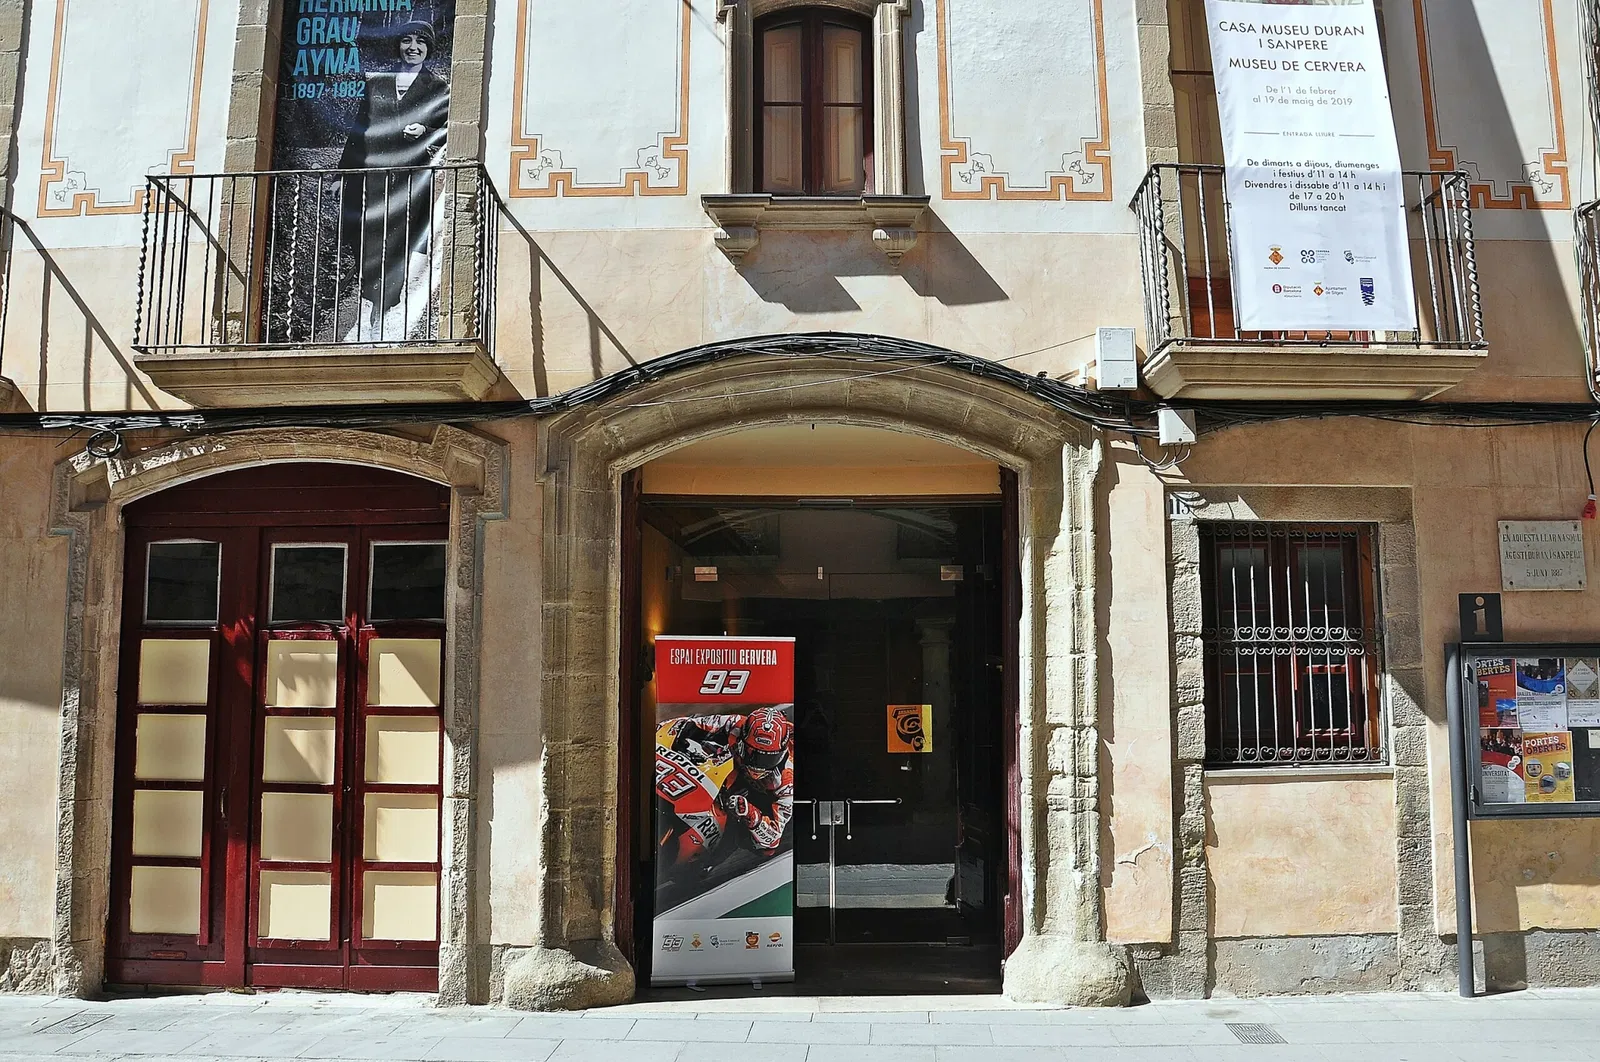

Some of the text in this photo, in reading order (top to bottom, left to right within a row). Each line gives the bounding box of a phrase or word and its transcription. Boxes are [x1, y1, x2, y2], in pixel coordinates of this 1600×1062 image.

[296, 16, 358, 45] GRAU
[1219, 21, 1364, 36] CASA MUSEU DURAN
[1259, 39, 1328, 50] I SANPERE
[293, 42, 361, 76] AYMÀ
[1229, 58, 1366, 72] MUSEU DE CERVERA
[1266, 86, 1278, 94] De
[1296, 86, 1307, 94] de
[1309, 86, 1336, 95] febrer
[1292, 98, 1314, 107] maig
[1330, 98, 1353, 106] 2019
[1262, 159, 1293, 167] dimarts
[1304, 160, 1332, 169] dijous,
[1335, 161, 1379, 170] diumenges
[1244, 181, 1287, 189] Divendres
[1295, 181, 1329, 189] dissabte
[1363, 182, 1373, 190] 14
[1375, 182, 1380, 190] h
[1290, 203, 1317, 211] Dilluns
[670, 648, 777, 665] ESPAI EXPOSITIU CERVERA
[699, 670, 751, 695] 93
[1525, 736, 1559, 747] PORTES
[1527, 743, 1566, 754] OBERTES
[656, 747, 706, 784] REPSOL
